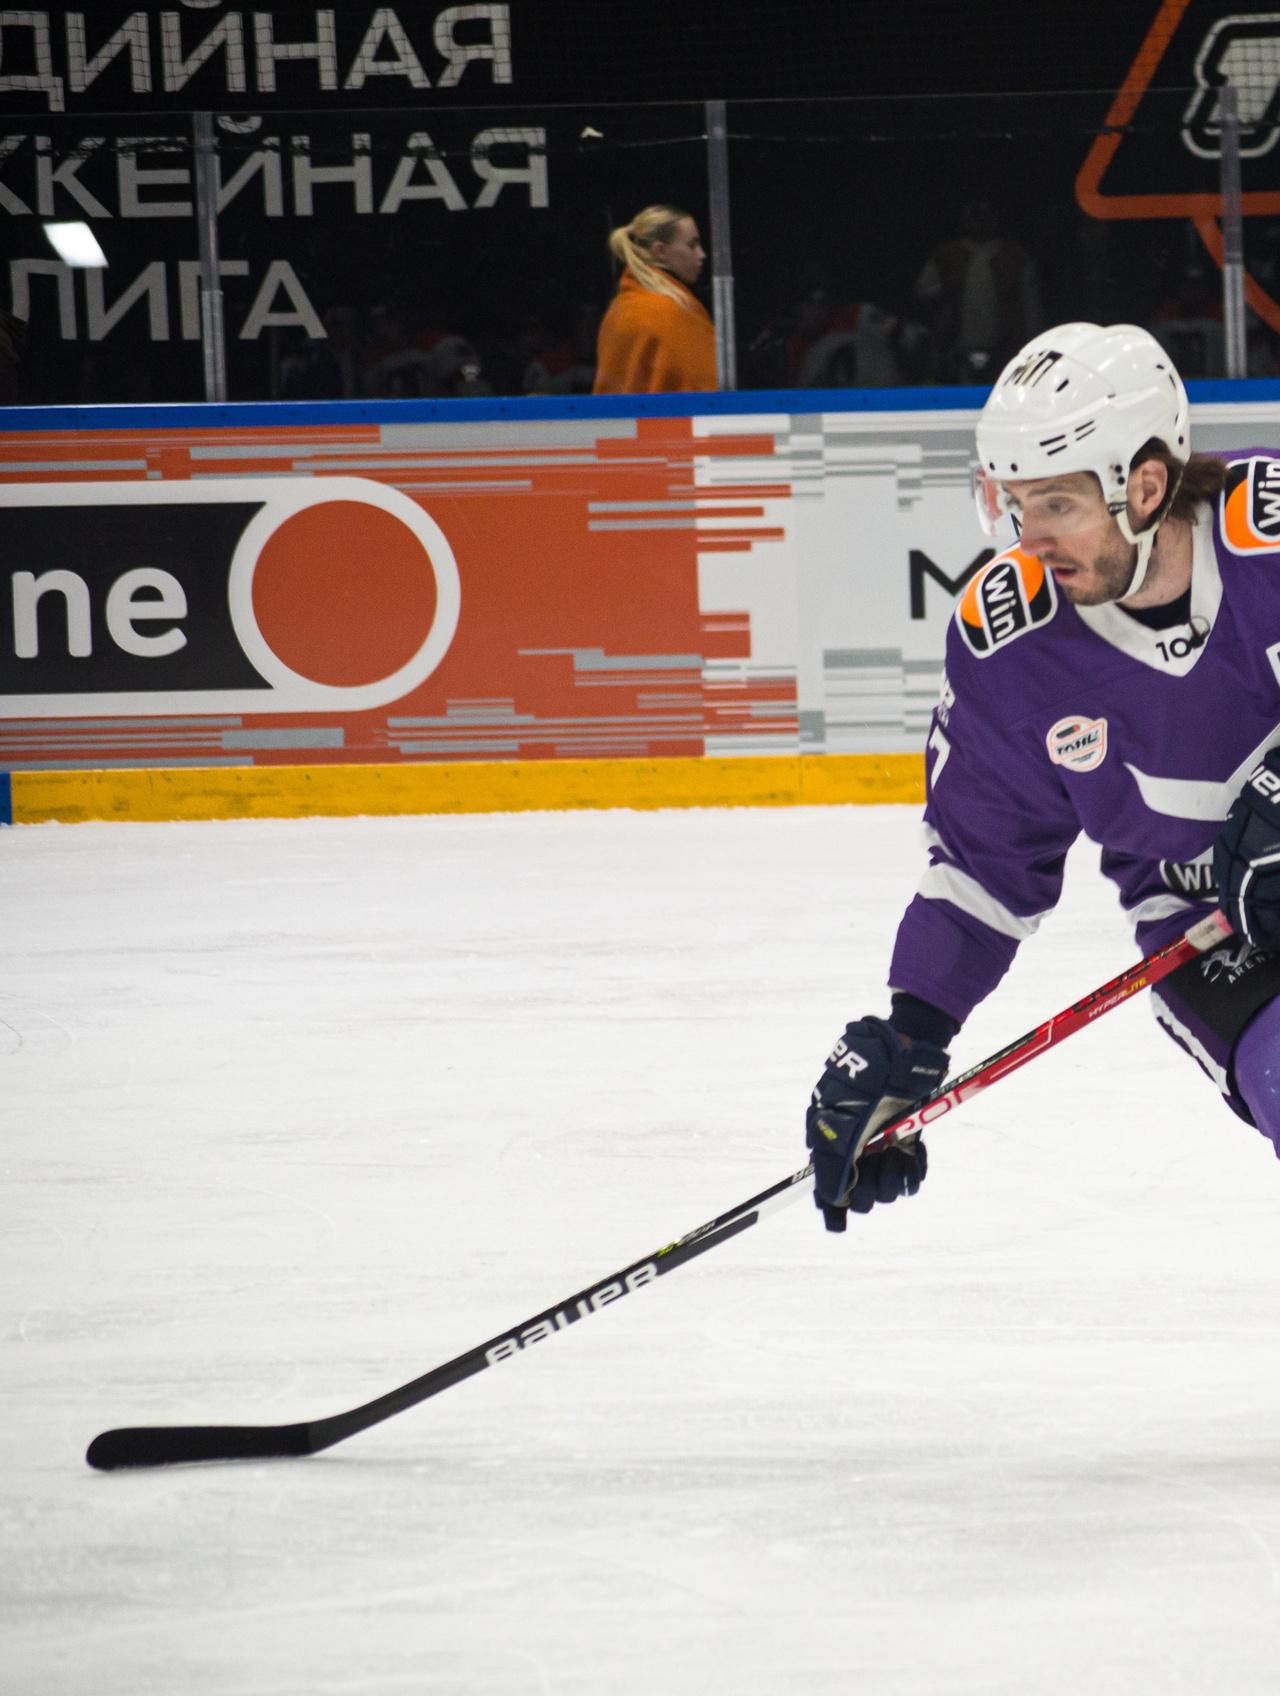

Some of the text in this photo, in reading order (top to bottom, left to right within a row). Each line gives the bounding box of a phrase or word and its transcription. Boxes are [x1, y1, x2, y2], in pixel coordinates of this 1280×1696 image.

[10, 257, 328, 342] ЛИГА
[12, 566, 188, 659] ne
[984, 565, 1017, 640] Win
[1172, 862, 1219, 891] WI
